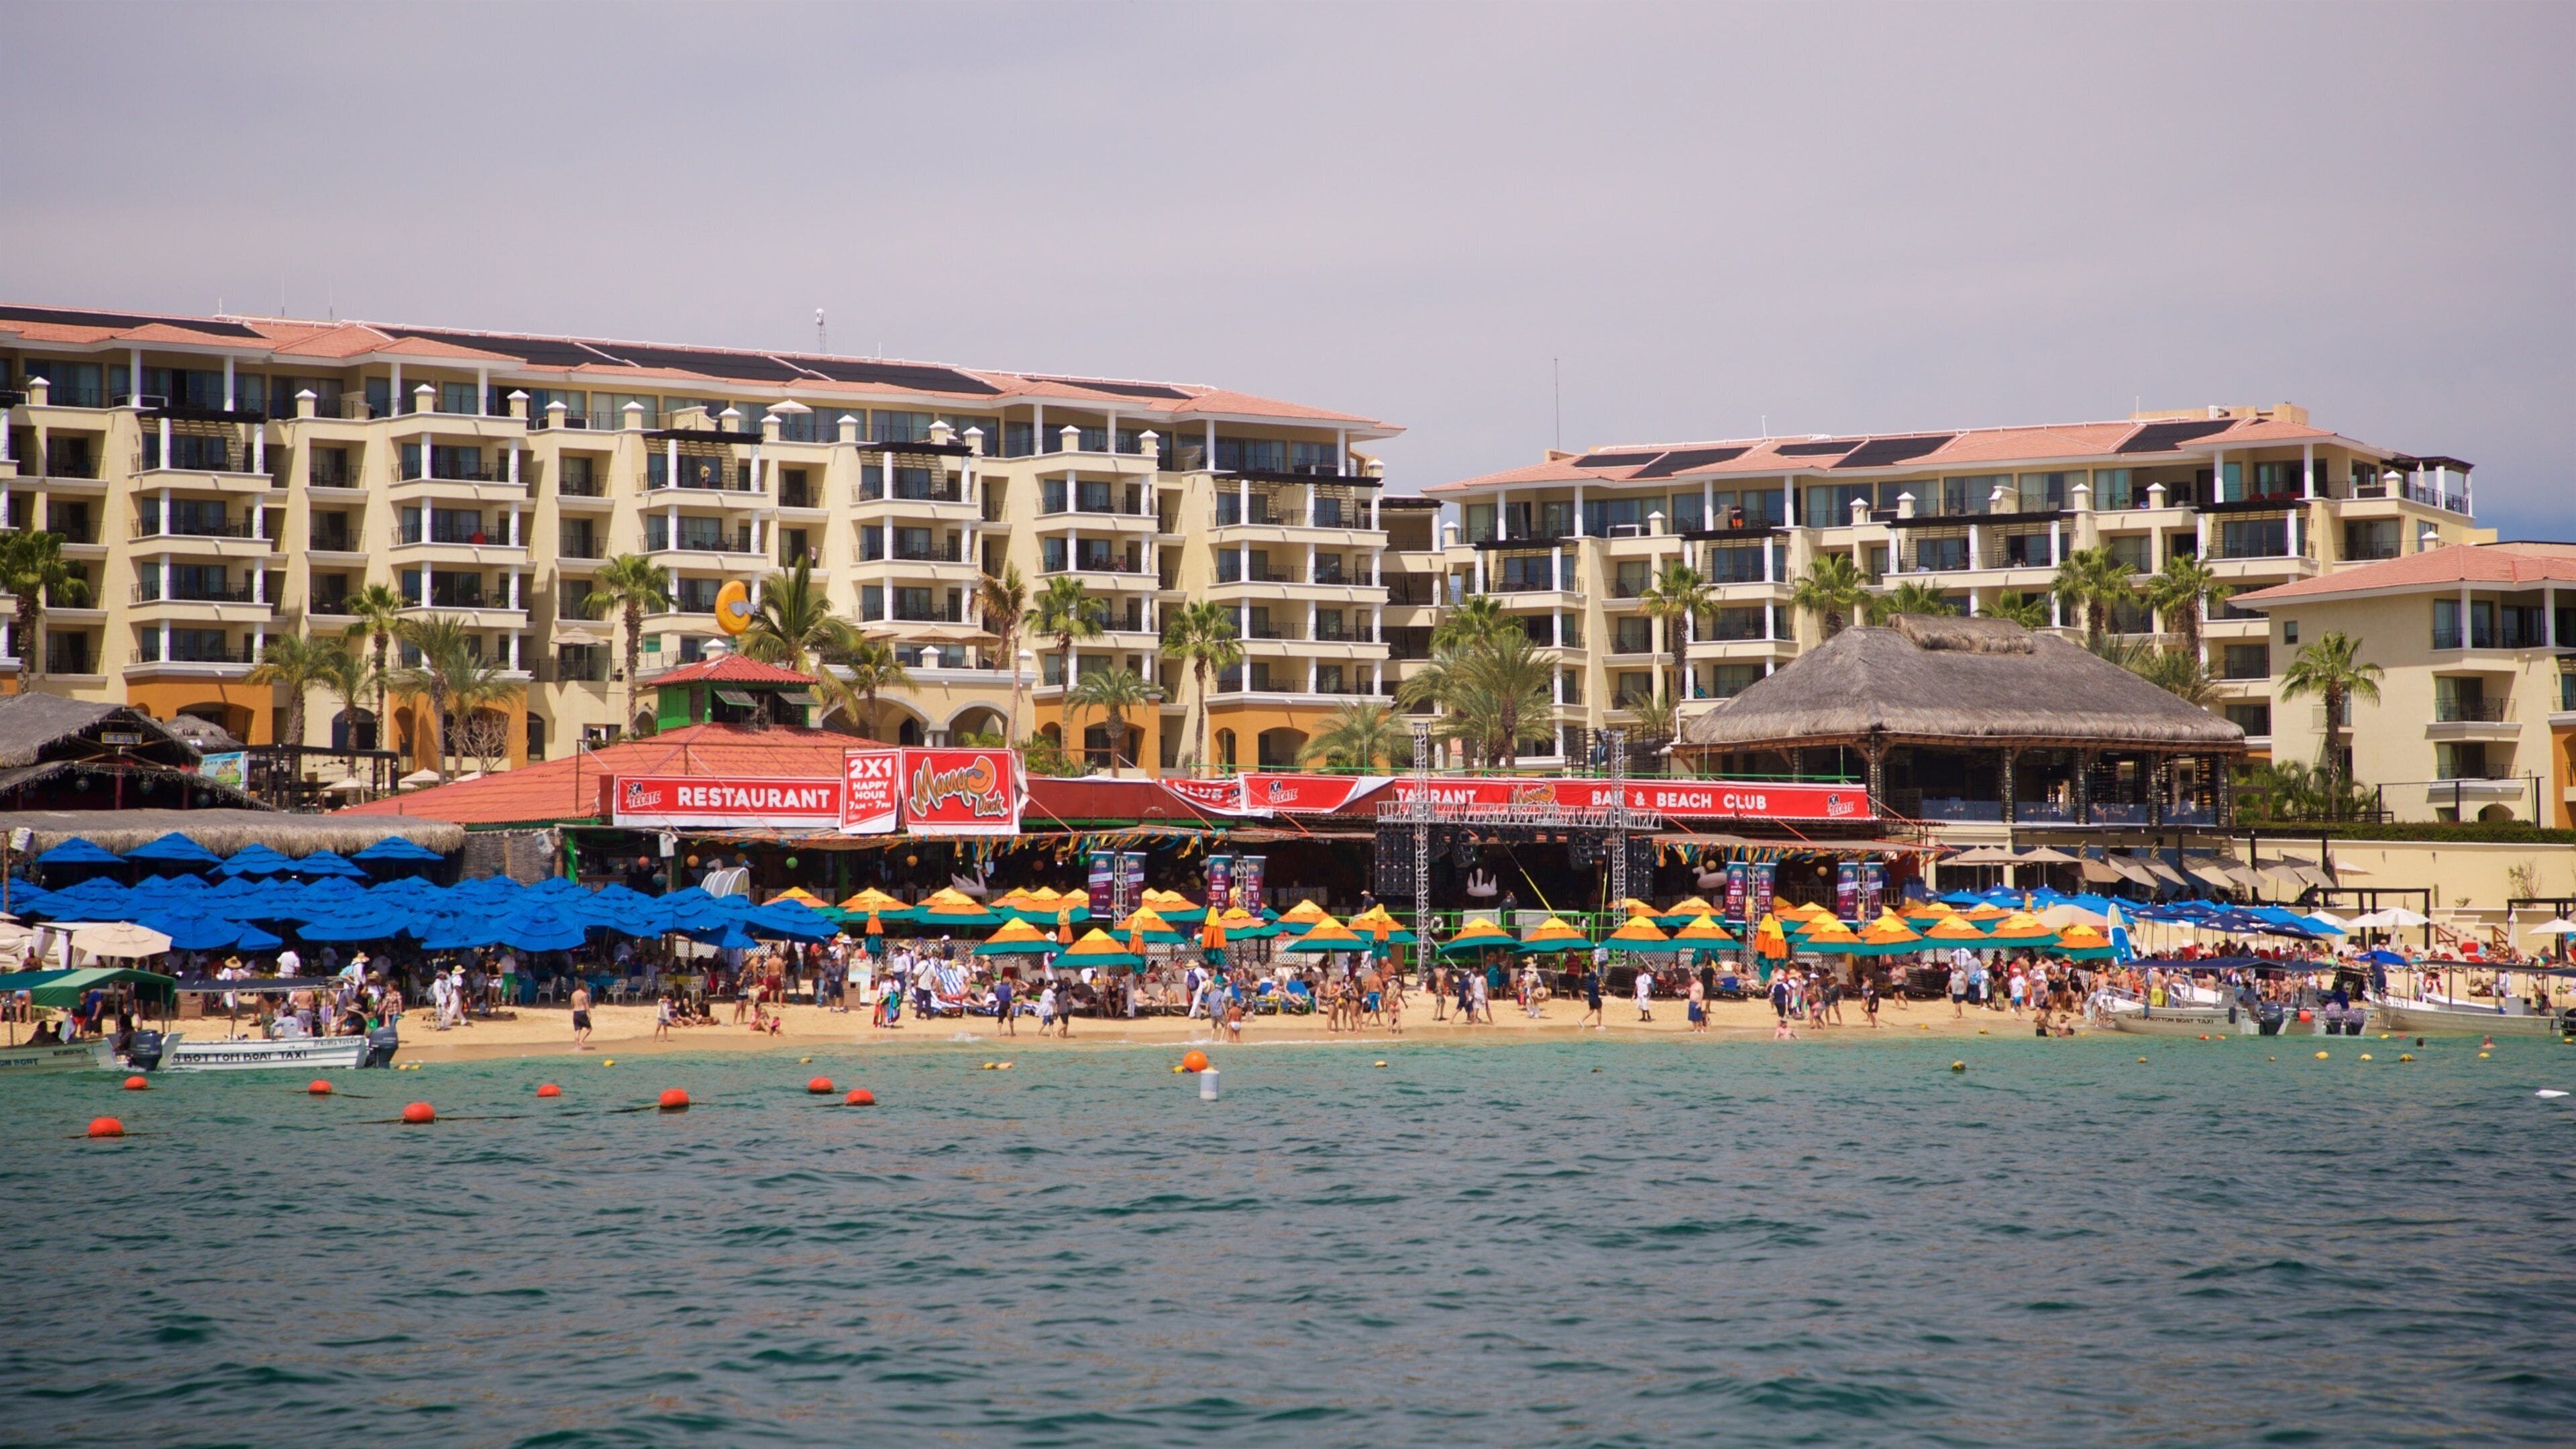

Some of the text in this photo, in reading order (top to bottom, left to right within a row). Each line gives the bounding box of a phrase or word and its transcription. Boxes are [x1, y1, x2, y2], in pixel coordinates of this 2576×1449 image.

[849, 757, 892, 779] 2X1
[853, 781, 888, 790] HAPPY
[1174, 781, 1223, 801] CLUB
[626, 790, 662, 808] TECATE
[678, 787, 830, 808] RESTAURANT
[855, 790, 886, 800] HOUR
[1268, 788, 1298, 804] TECATE
[1635, 792, 1645, 806] &
[1656, 792, 1712, 808] BEACH
[1723, 794, 1767, 810] CLUB
[1827, 801, 1854, 817] TECATE
[243, 1052, 272, 1061] BOAT
[278, 1051, 307, 1059] TAXI
